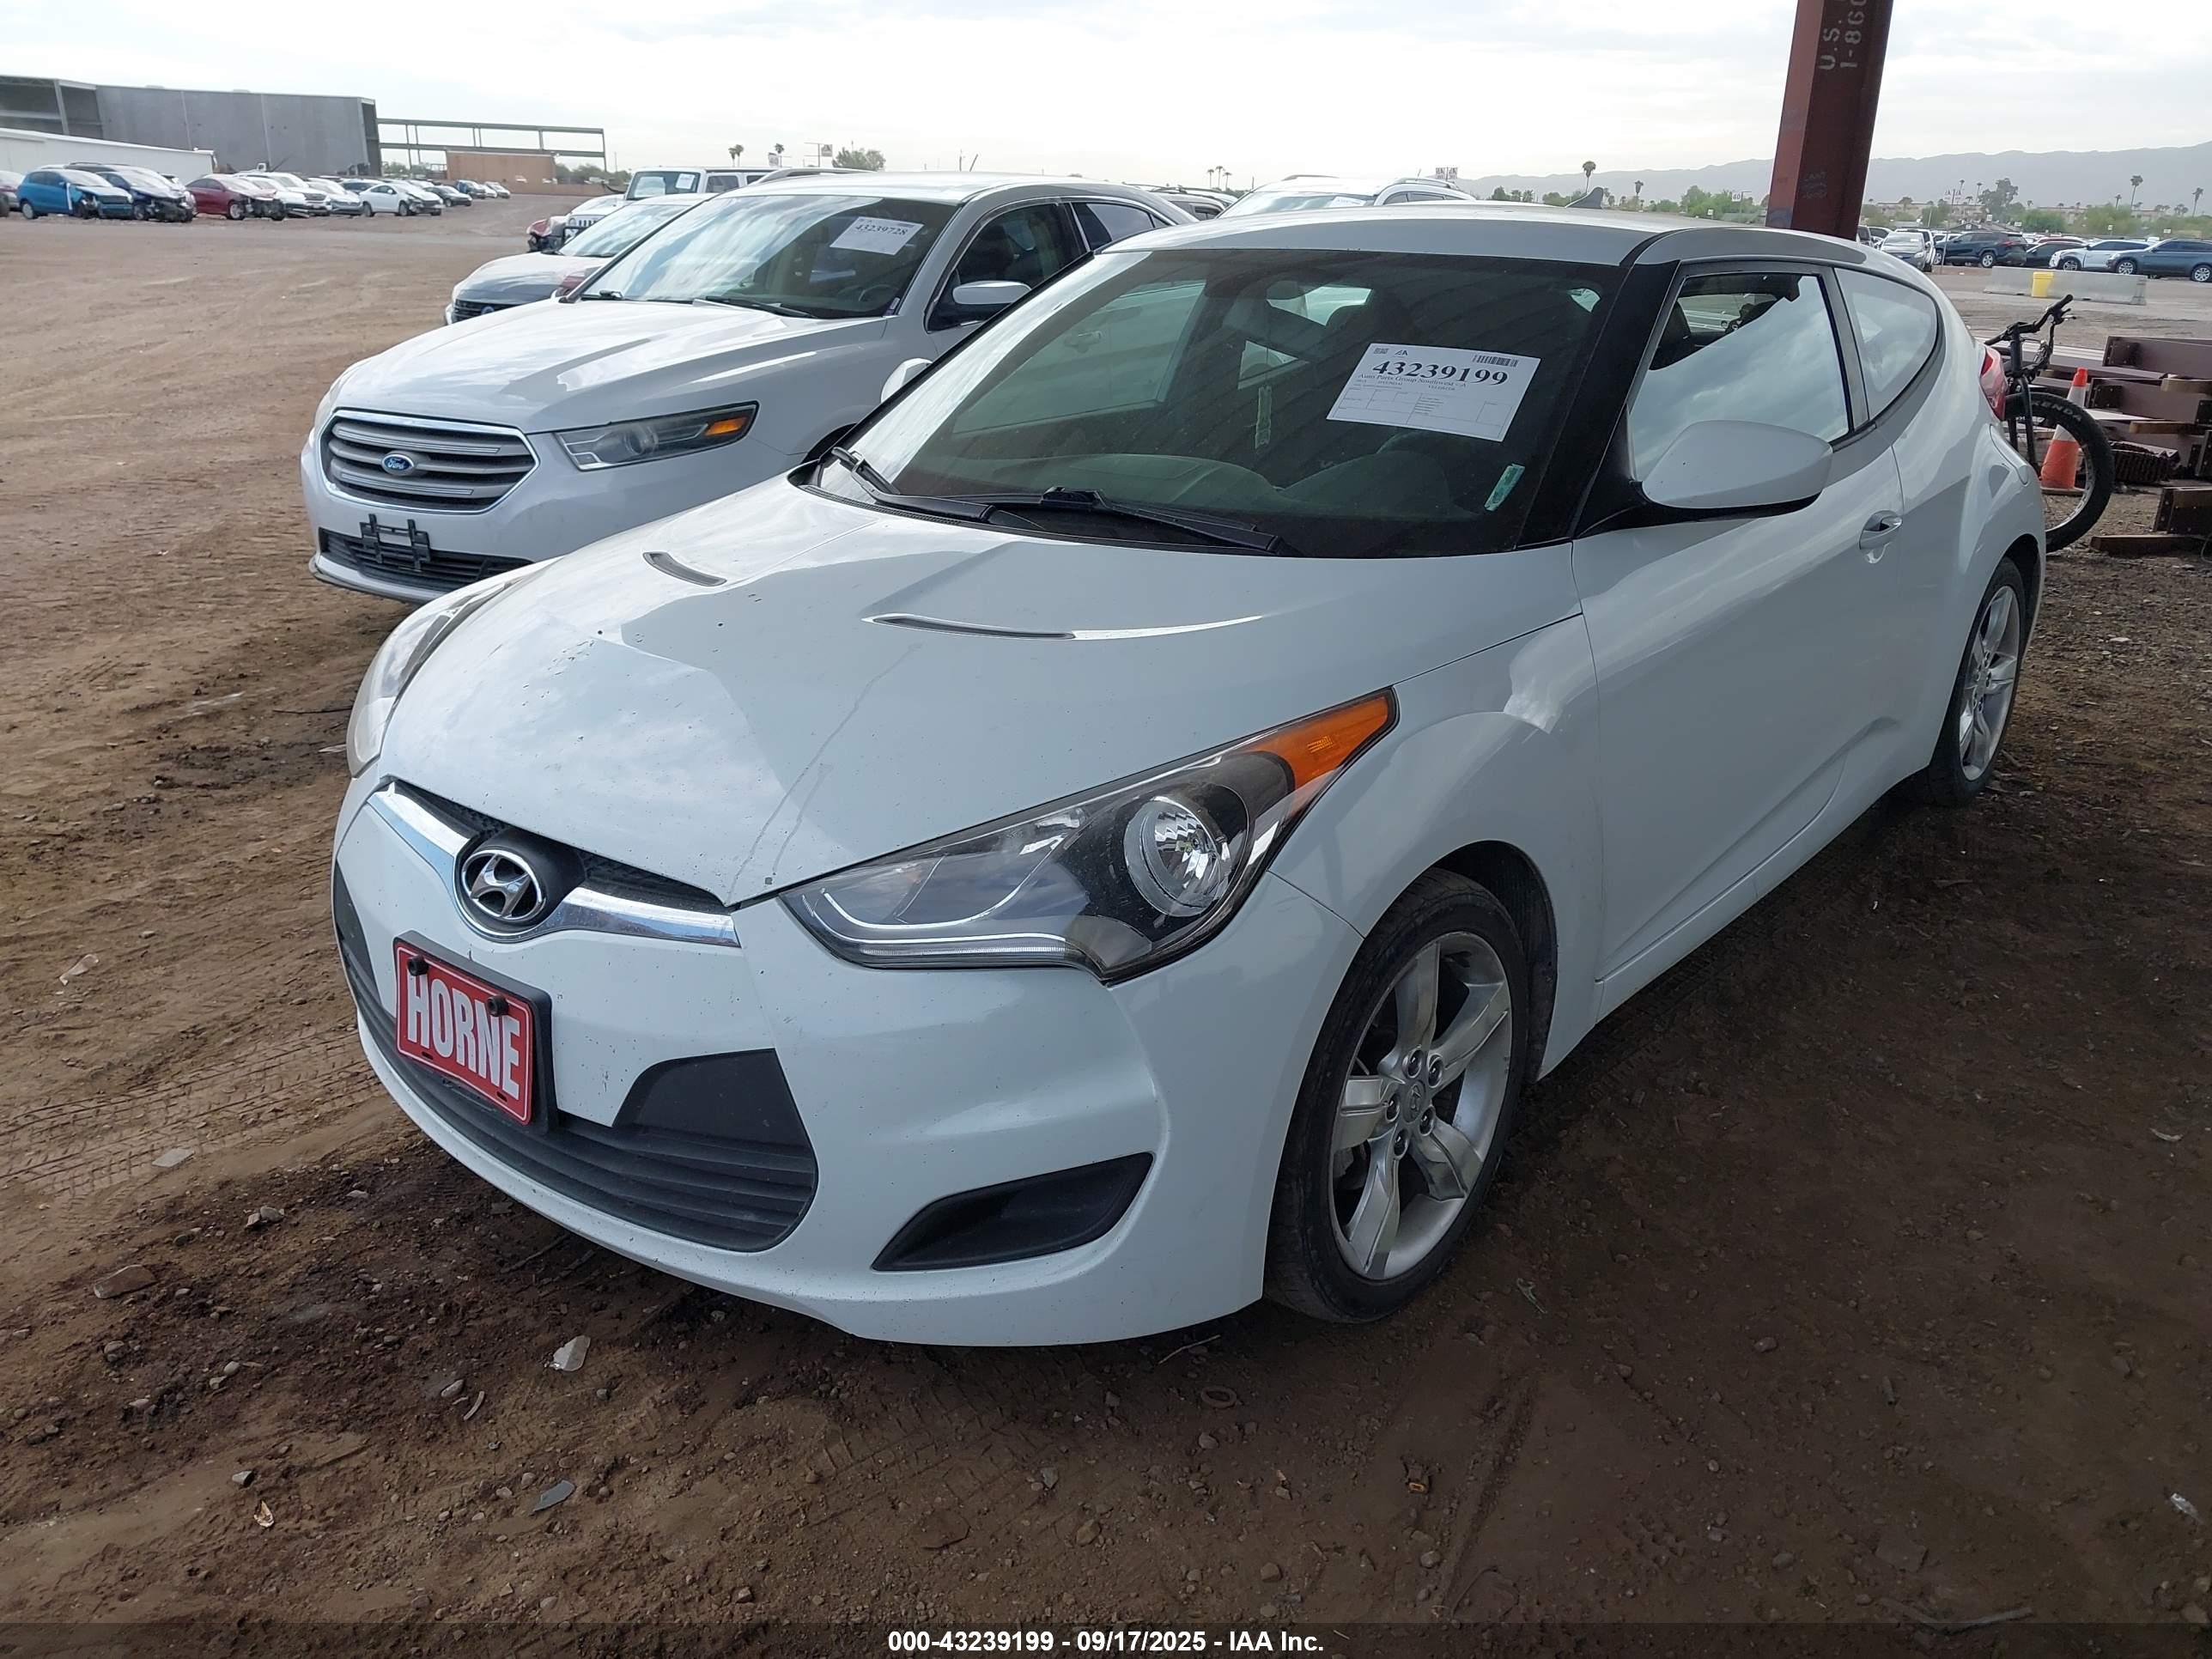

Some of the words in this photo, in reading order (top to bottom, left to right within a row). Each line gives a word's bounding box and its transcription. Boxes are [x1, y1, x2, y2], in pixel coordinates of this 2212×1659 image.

[1372, 361, 1509, 386] 43239199
[2030, 400, 2082, 422] KENDA
[387, 457, 405, 470] Ford
[407, 970, 520, 1100] HORNE
